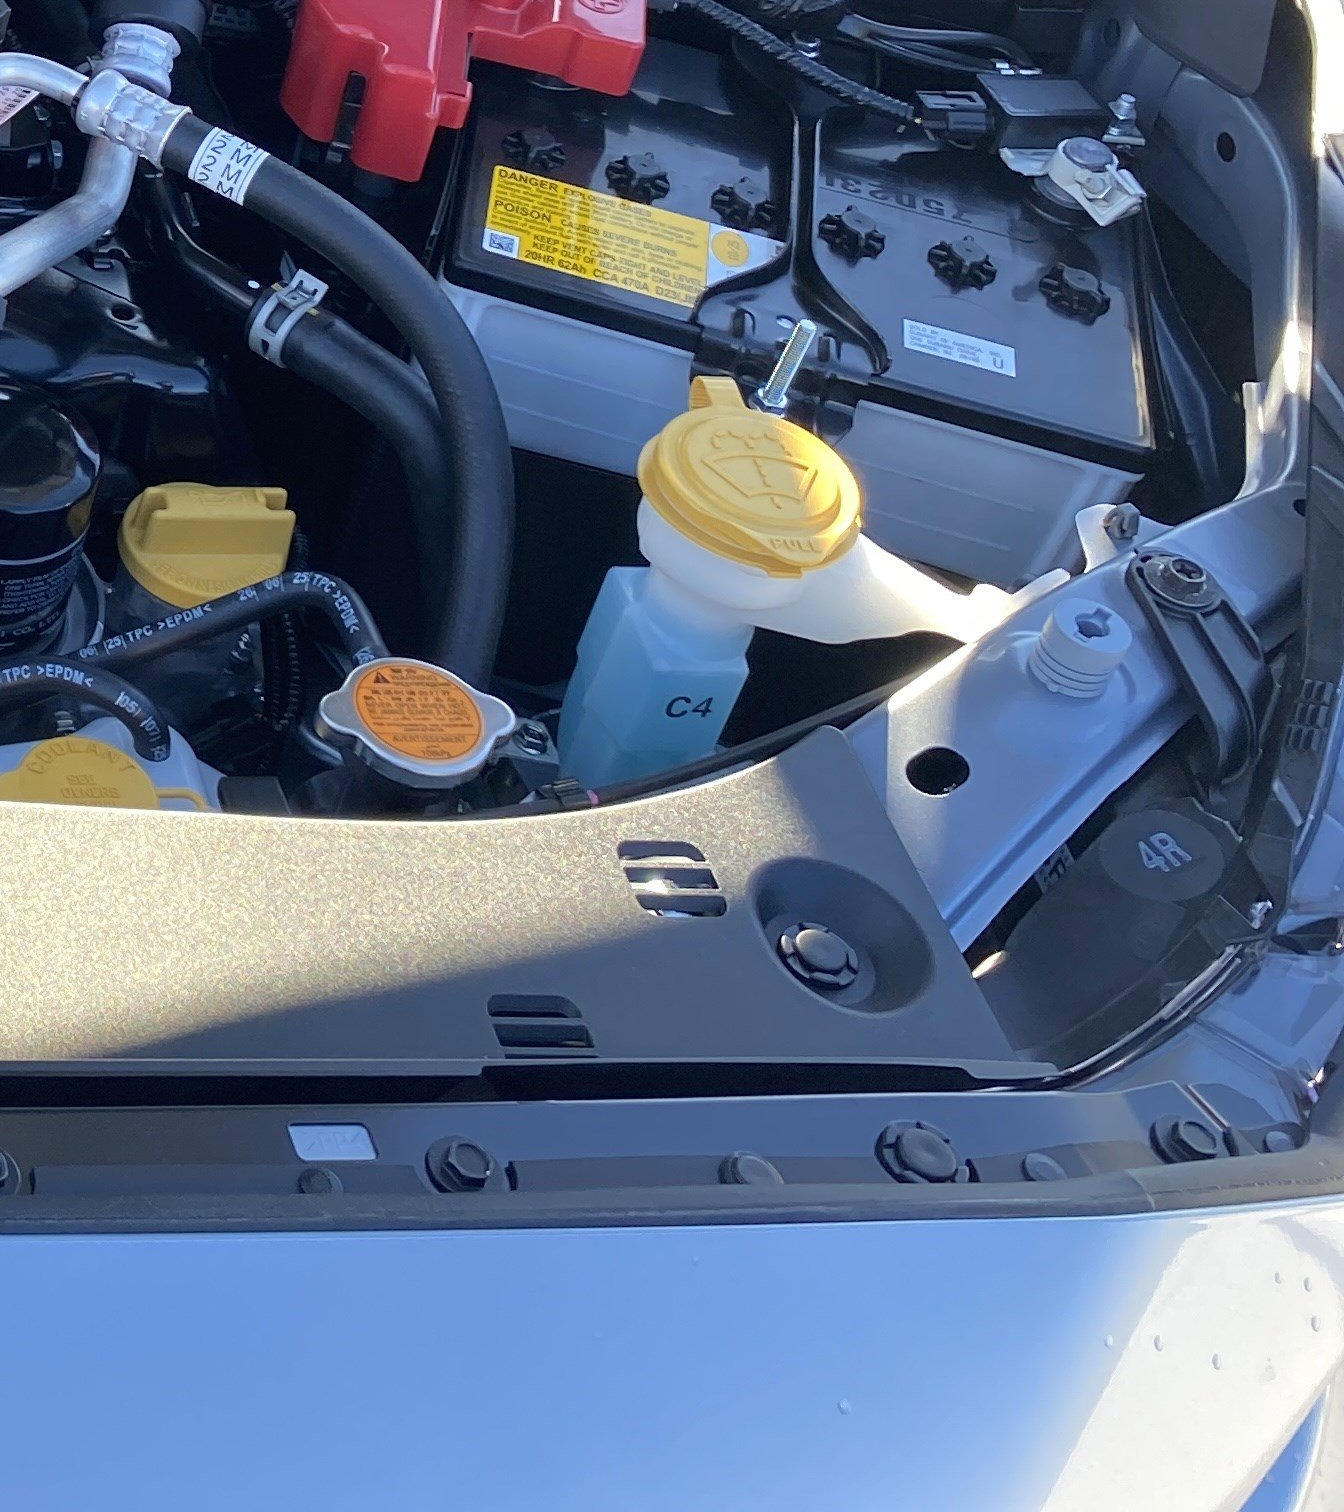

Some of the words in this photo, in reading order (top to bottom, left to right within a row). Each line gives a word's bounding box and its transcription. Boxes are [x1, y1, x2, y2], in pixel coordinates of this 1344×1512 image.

[210, 139, 227, 155] 2
[230, 148, 253, 168] M
[201, 155, 217, 172] 2
[221, 163, 243, 185] M
[497, 168, 558, 192] DANGER
[493, 199, 552, 223] POISON
[992, 356, 1004, 370] U
[769, 538, 823, 554] PULL
[312, 573, 337, 593] TPC
[126, 623, 154, 644] TPC
[156, 603, 213, 631] >EPDM<
[2, 664, 31, 683] TPC
[36, 663, 94, 688] >EPDM<
[665, 696, 713, 718] C4
[26, 739, 137, 775] COOLANT
[1138, 832, 1192, 873] 4R
